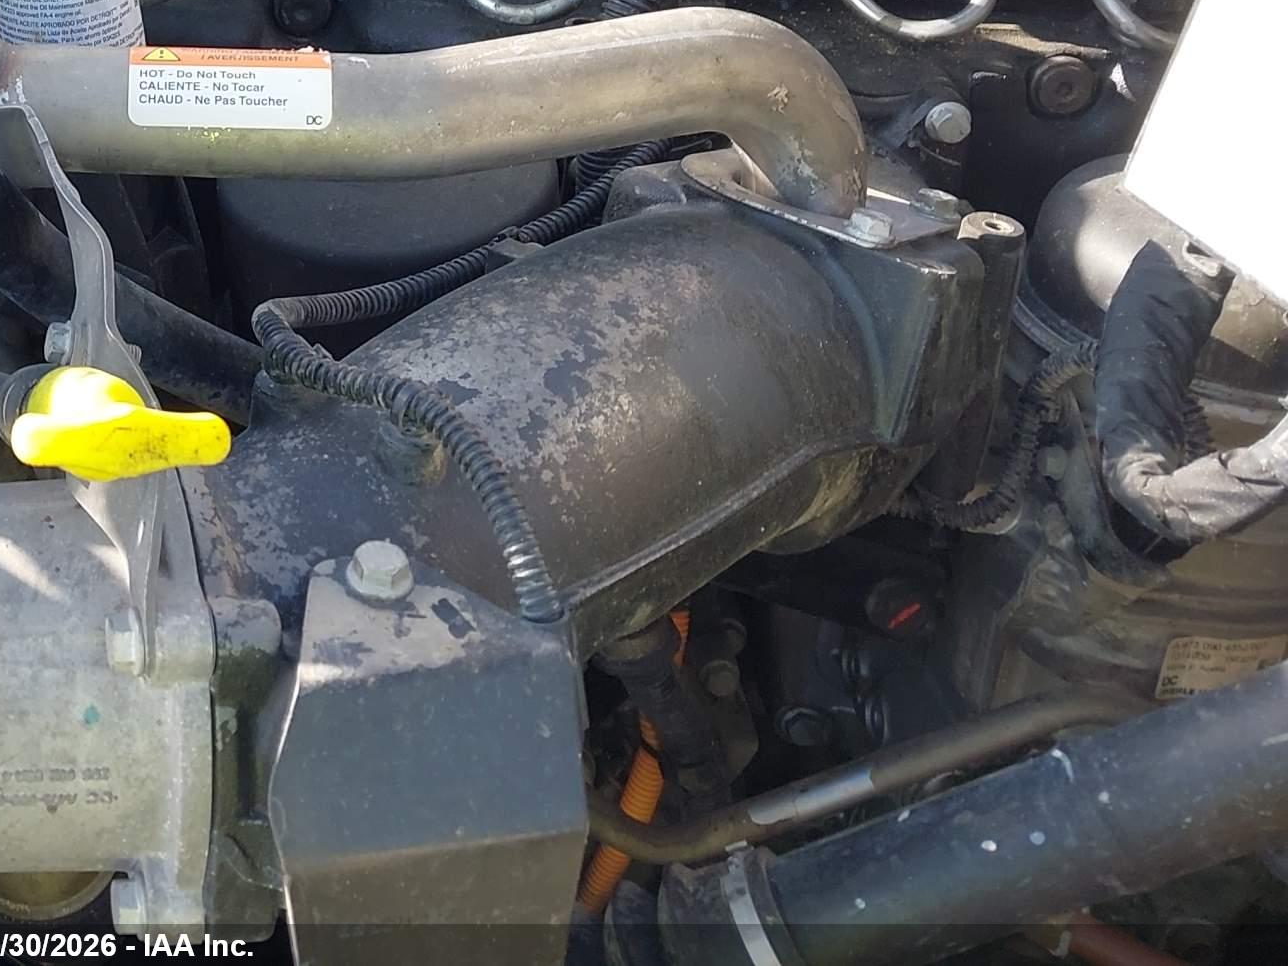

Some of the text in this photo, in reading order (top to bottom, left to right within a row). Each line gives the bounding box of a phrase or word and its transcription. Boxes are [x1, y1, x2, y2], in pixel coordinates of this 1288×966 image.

[139, 69, 166, 78] HOT
[176, 70, 193, 79] Do
[196, 70, 217, 79] Not
[219, 71, 256, 80] Touch
[139, 81, 201, 91] CALIENTE
[212, 82, 229, 92] No
[231, 82, 265, 92] Tocar
[138, 93, 184, 105] CHAUD
[194, 95, 211, 105] Ne
[214, 95, 236, 106] Pas
[238, 95, 288, 107] Toucher
[306, 115, 323, 126] DC
